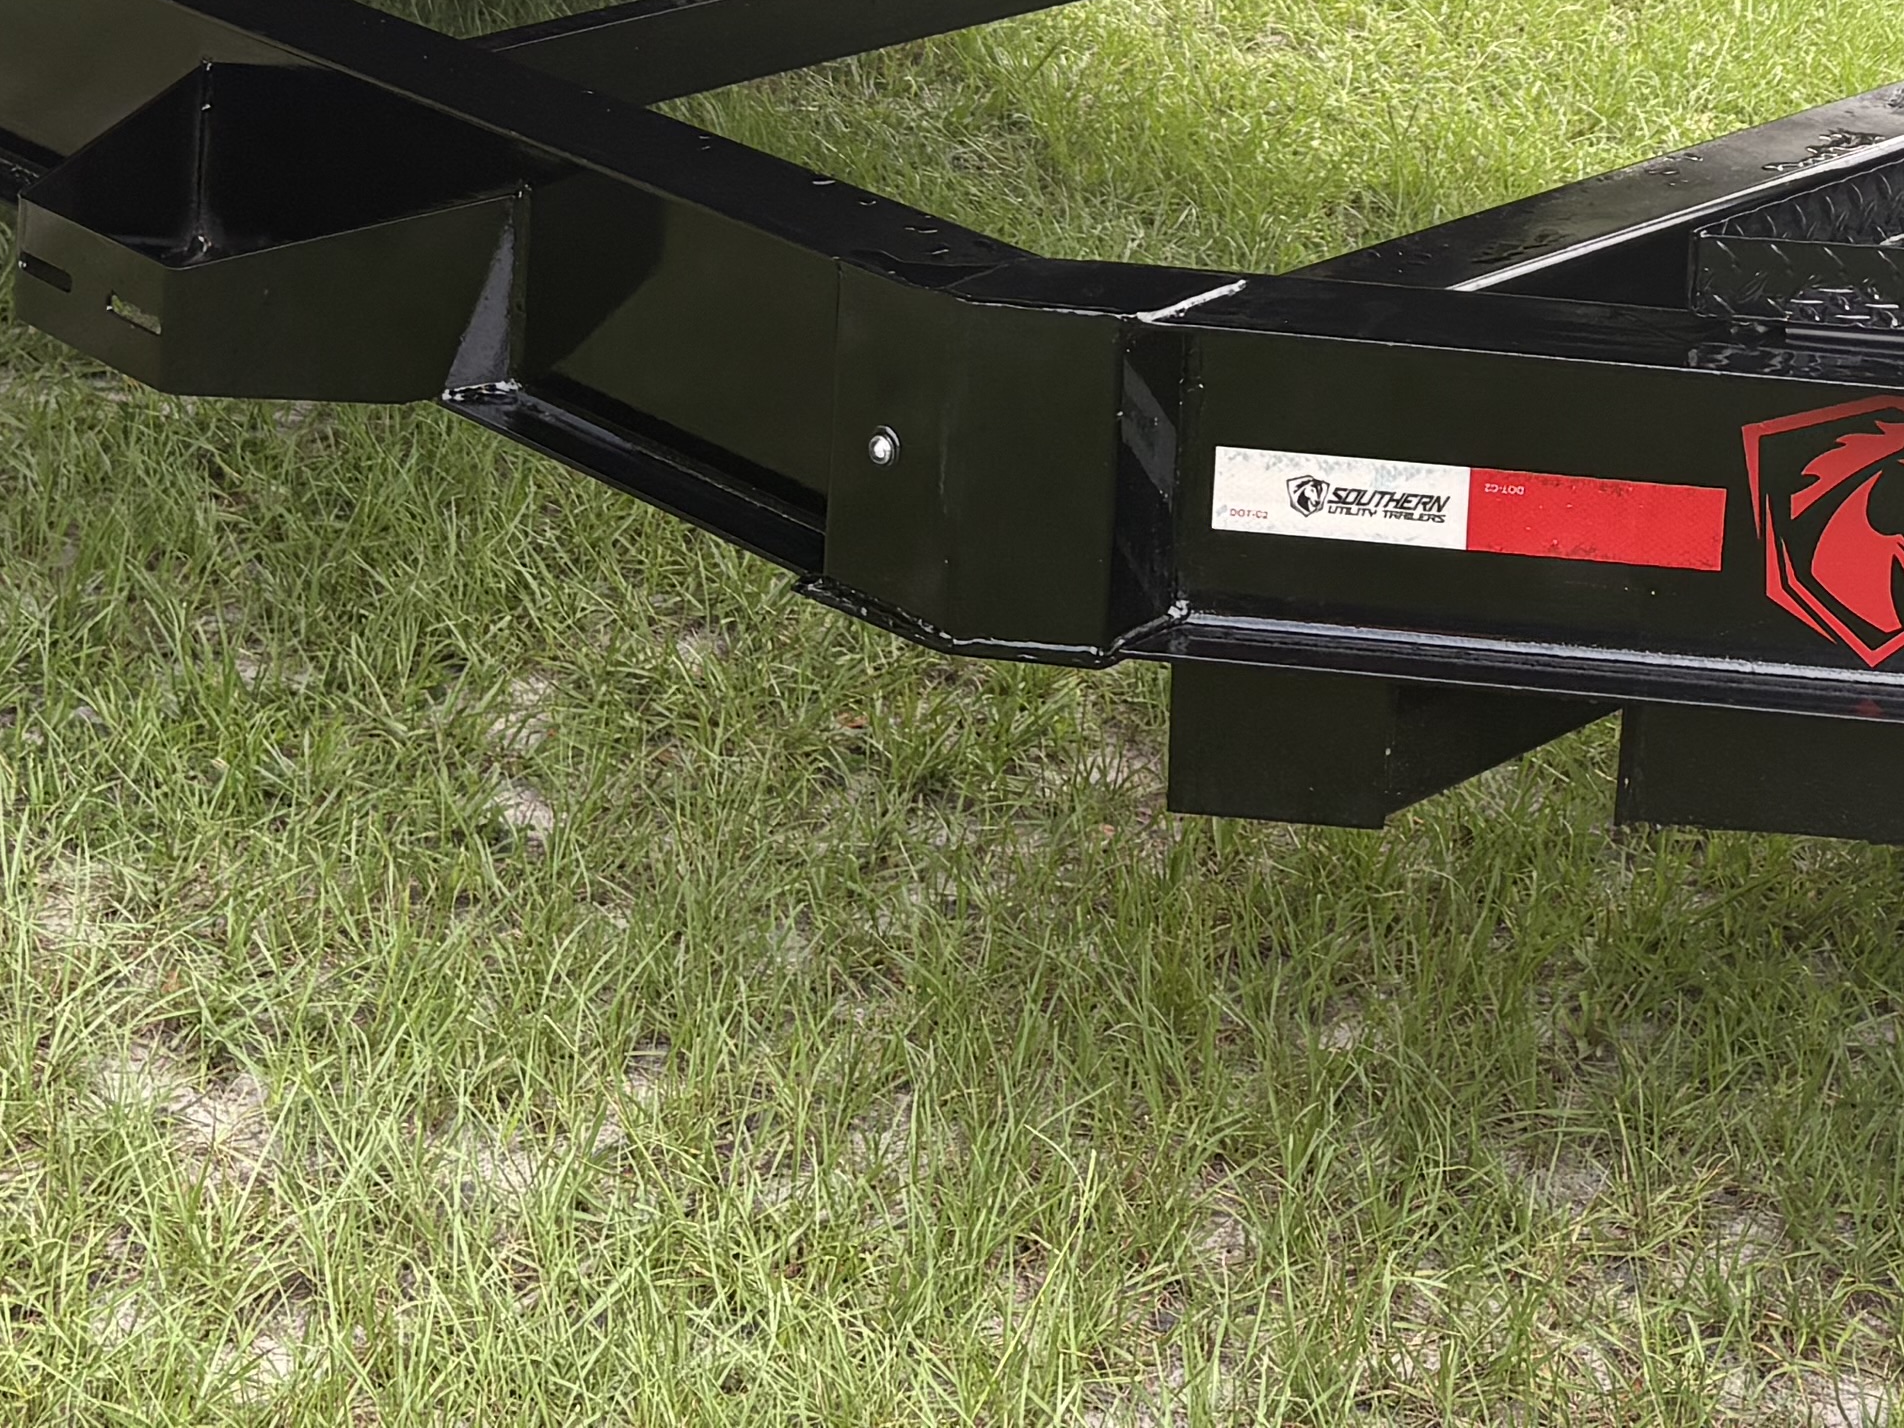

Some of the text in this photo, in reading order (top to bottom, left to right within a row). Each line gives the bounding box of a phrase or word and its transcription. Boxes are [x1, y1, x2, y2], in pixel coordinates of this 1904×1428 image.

[1484, 482, 1526, 496] DOT-C2
[1327, 486, 1449, 513] SOUTHERN
[1229, 507, 1269, 520] DOT-C2
[1327, 505, 1447, 524] UTILITY TRAILERS
